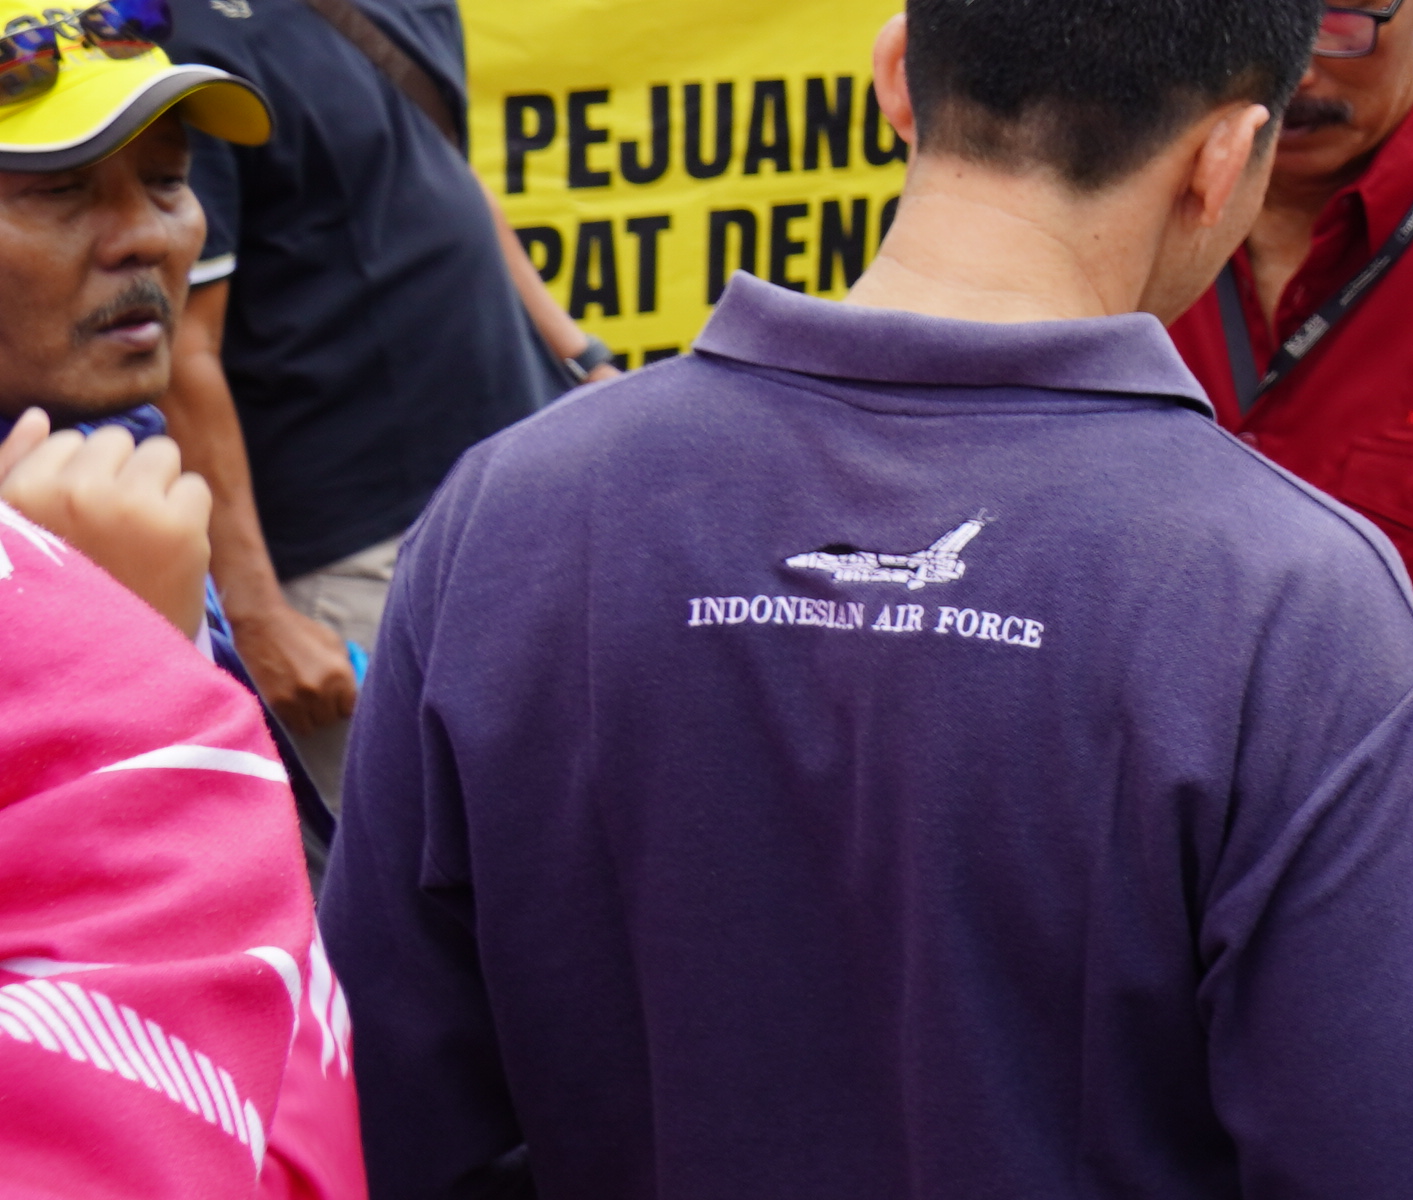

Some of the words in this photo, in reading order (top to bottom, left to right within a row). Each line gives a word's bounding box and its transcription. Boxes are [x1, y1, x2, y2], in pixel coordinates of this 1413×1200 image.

[688, 595, 865, 630] INDONESIAN
[872, 603, 923, 633] AIR
[935, 605, 1045, 649] FORCE
